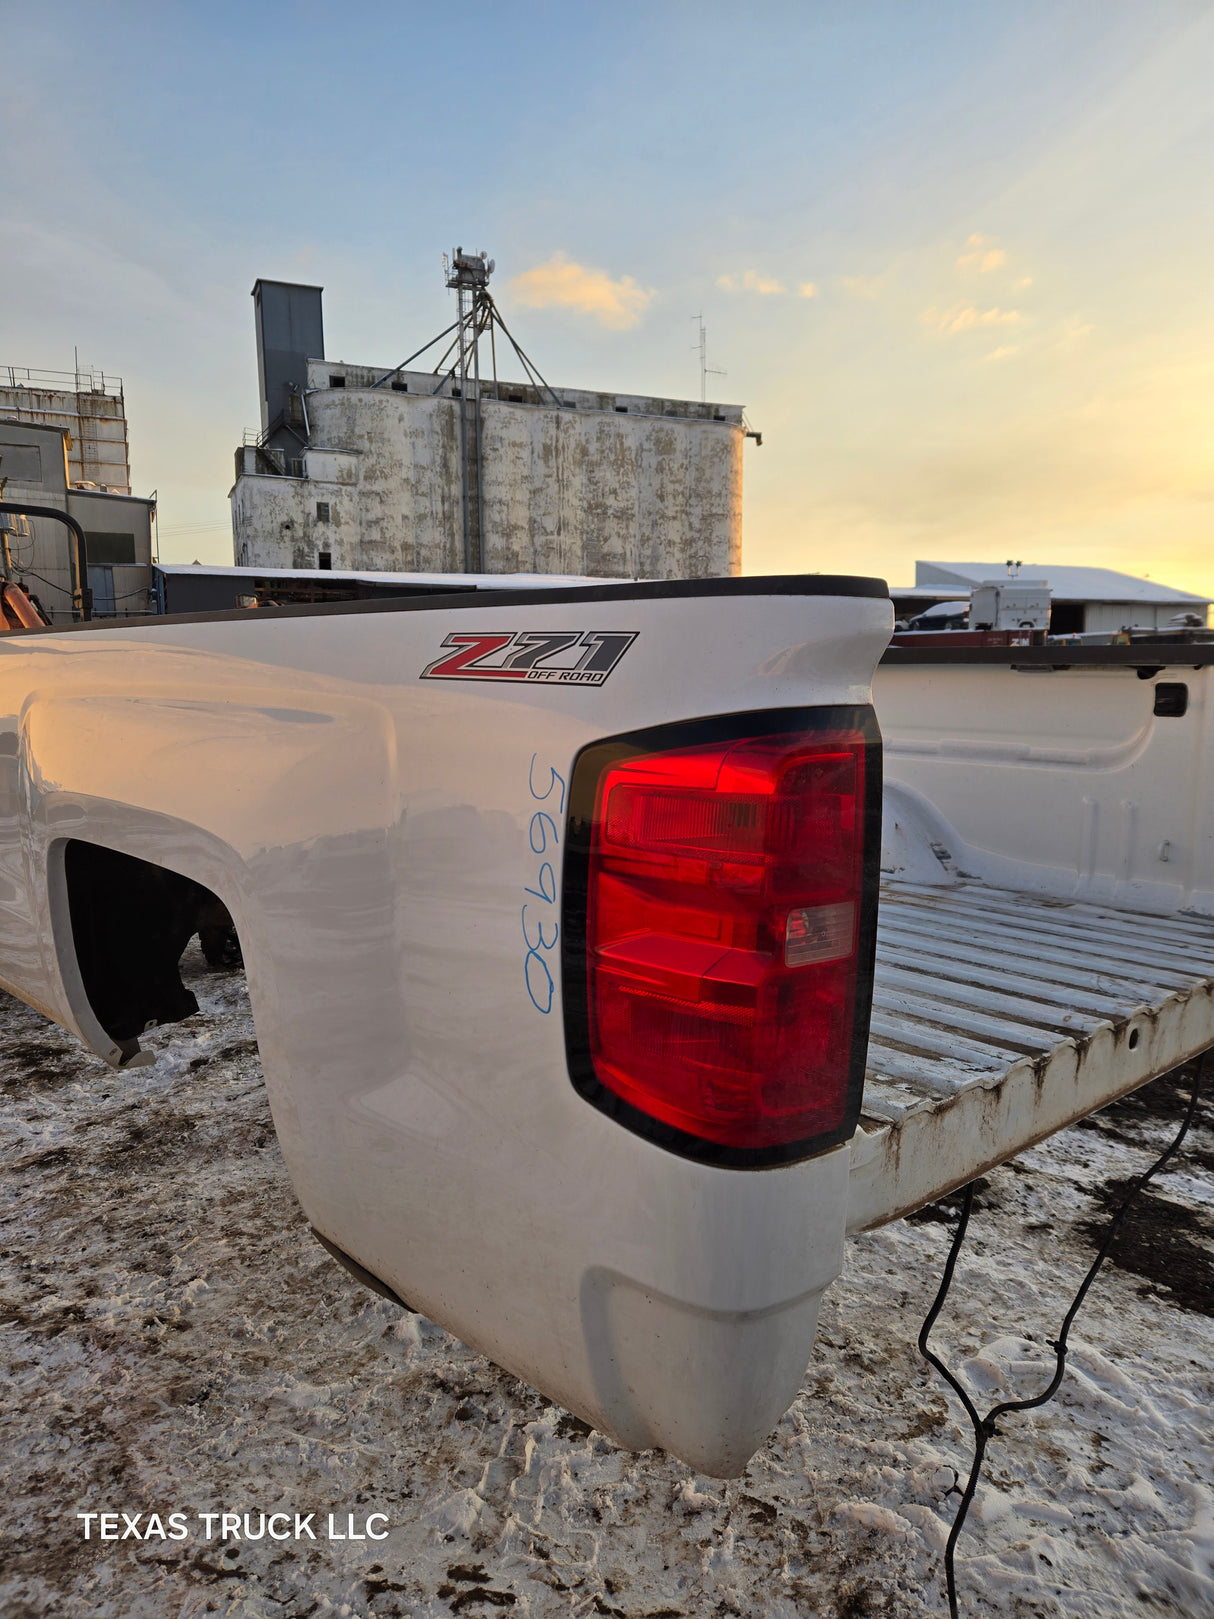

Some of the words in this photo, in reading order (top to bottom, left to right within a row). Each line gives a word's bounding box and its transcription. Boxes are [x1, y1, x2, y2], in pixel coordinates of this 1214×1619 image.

[420, 631, 640, 684] Z71
[527, 670, 557, 679] OFF
[559, 672, 604, 682] ROAD
[522, 752, 565, 1014] 56930
